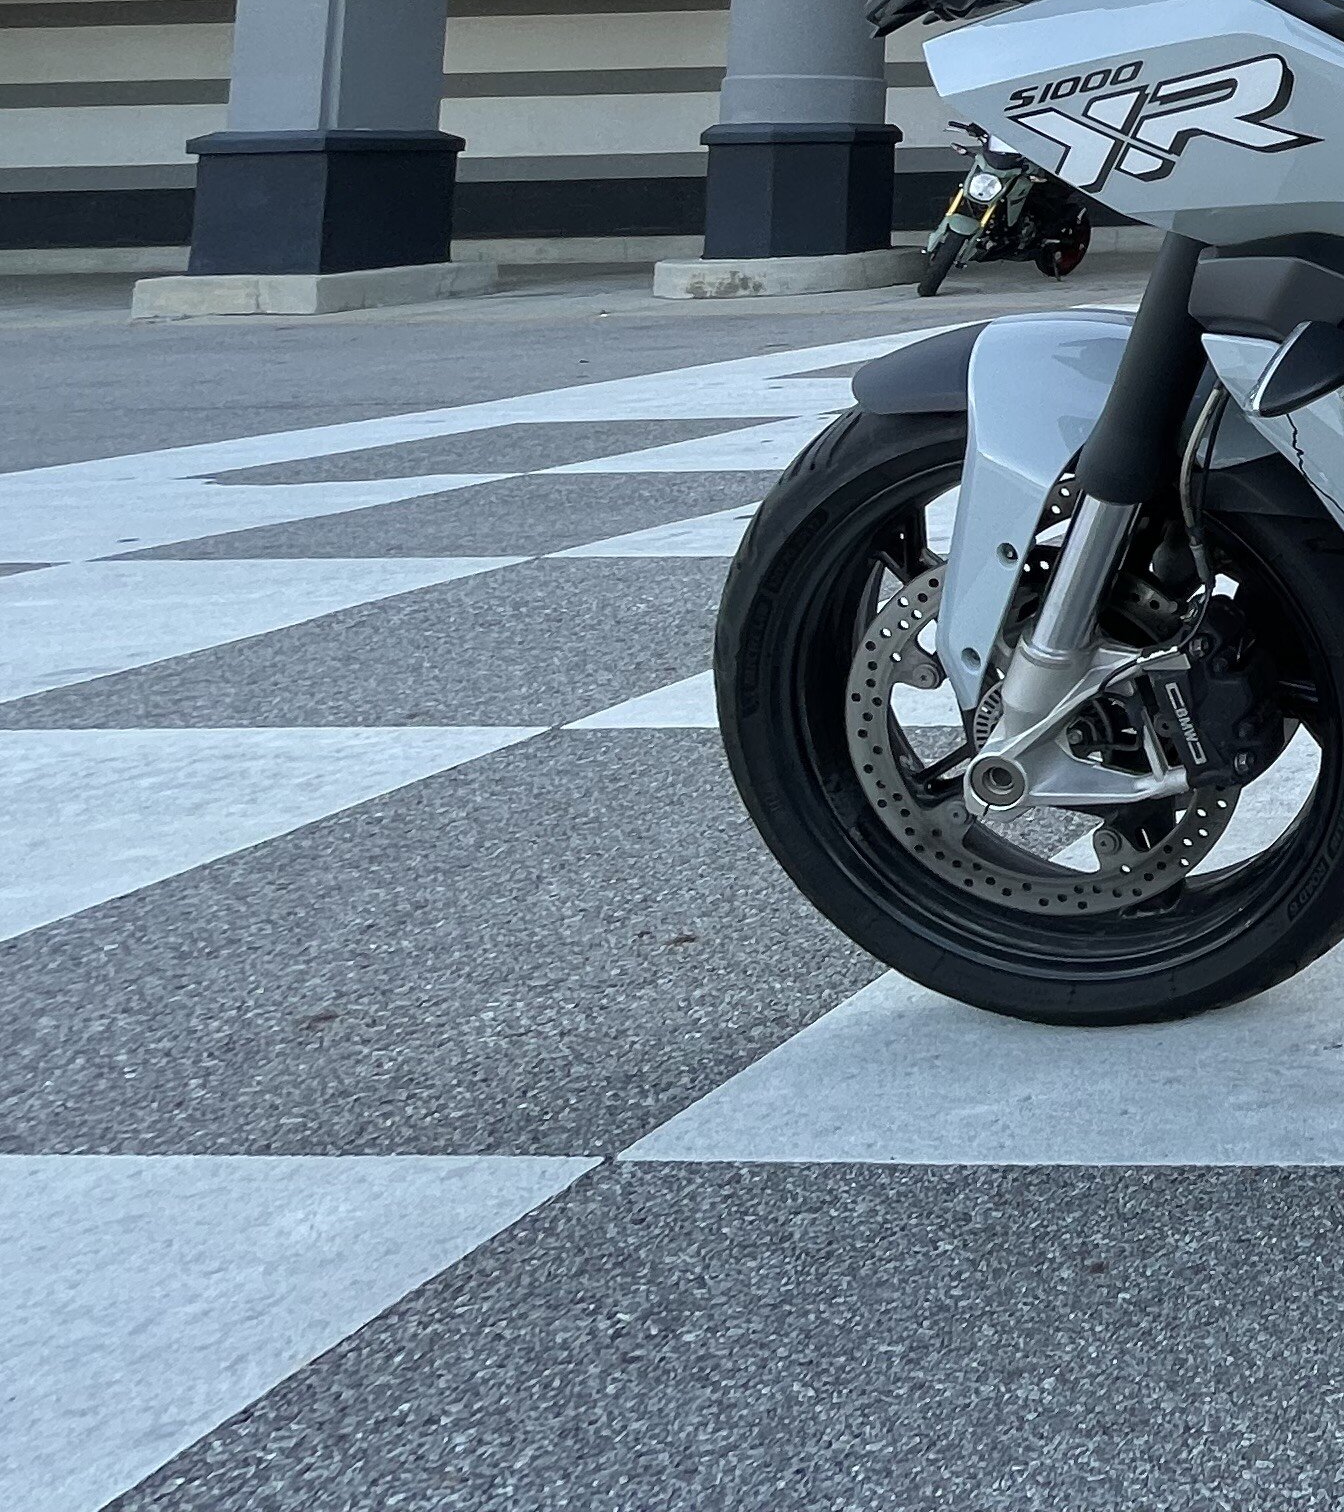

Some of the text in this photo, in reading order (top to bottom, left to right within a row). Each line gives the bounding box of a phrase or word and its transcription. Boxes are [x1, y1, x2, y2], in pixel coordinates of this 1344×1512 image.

[1004, 60, 1144, 112] S1000
[1007, 53, 1324, 192] XR
[1174, 707, 1200, 742] BMW
